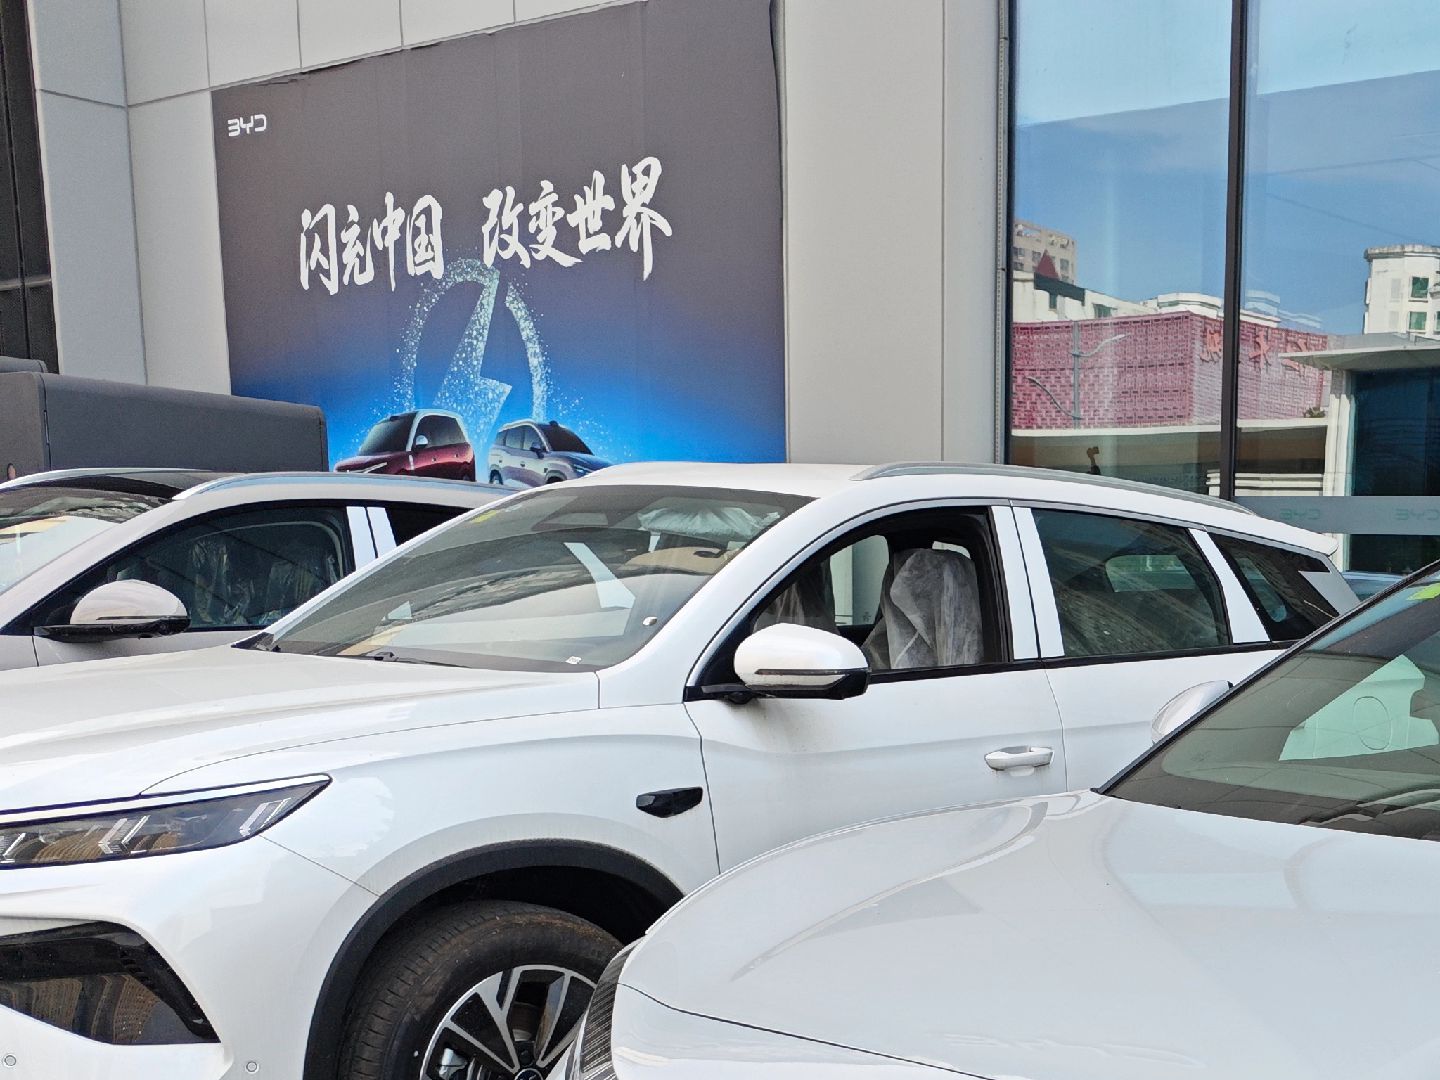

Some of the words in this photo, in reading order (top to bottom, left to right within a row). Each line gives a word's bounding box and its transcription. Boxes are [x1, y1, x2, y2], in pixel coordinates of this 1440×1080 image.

[227, 113, 267, 137] BYD
[299, 191, 446, 295] 闪充中国
[481, 156, 673, 281] 改变世界
